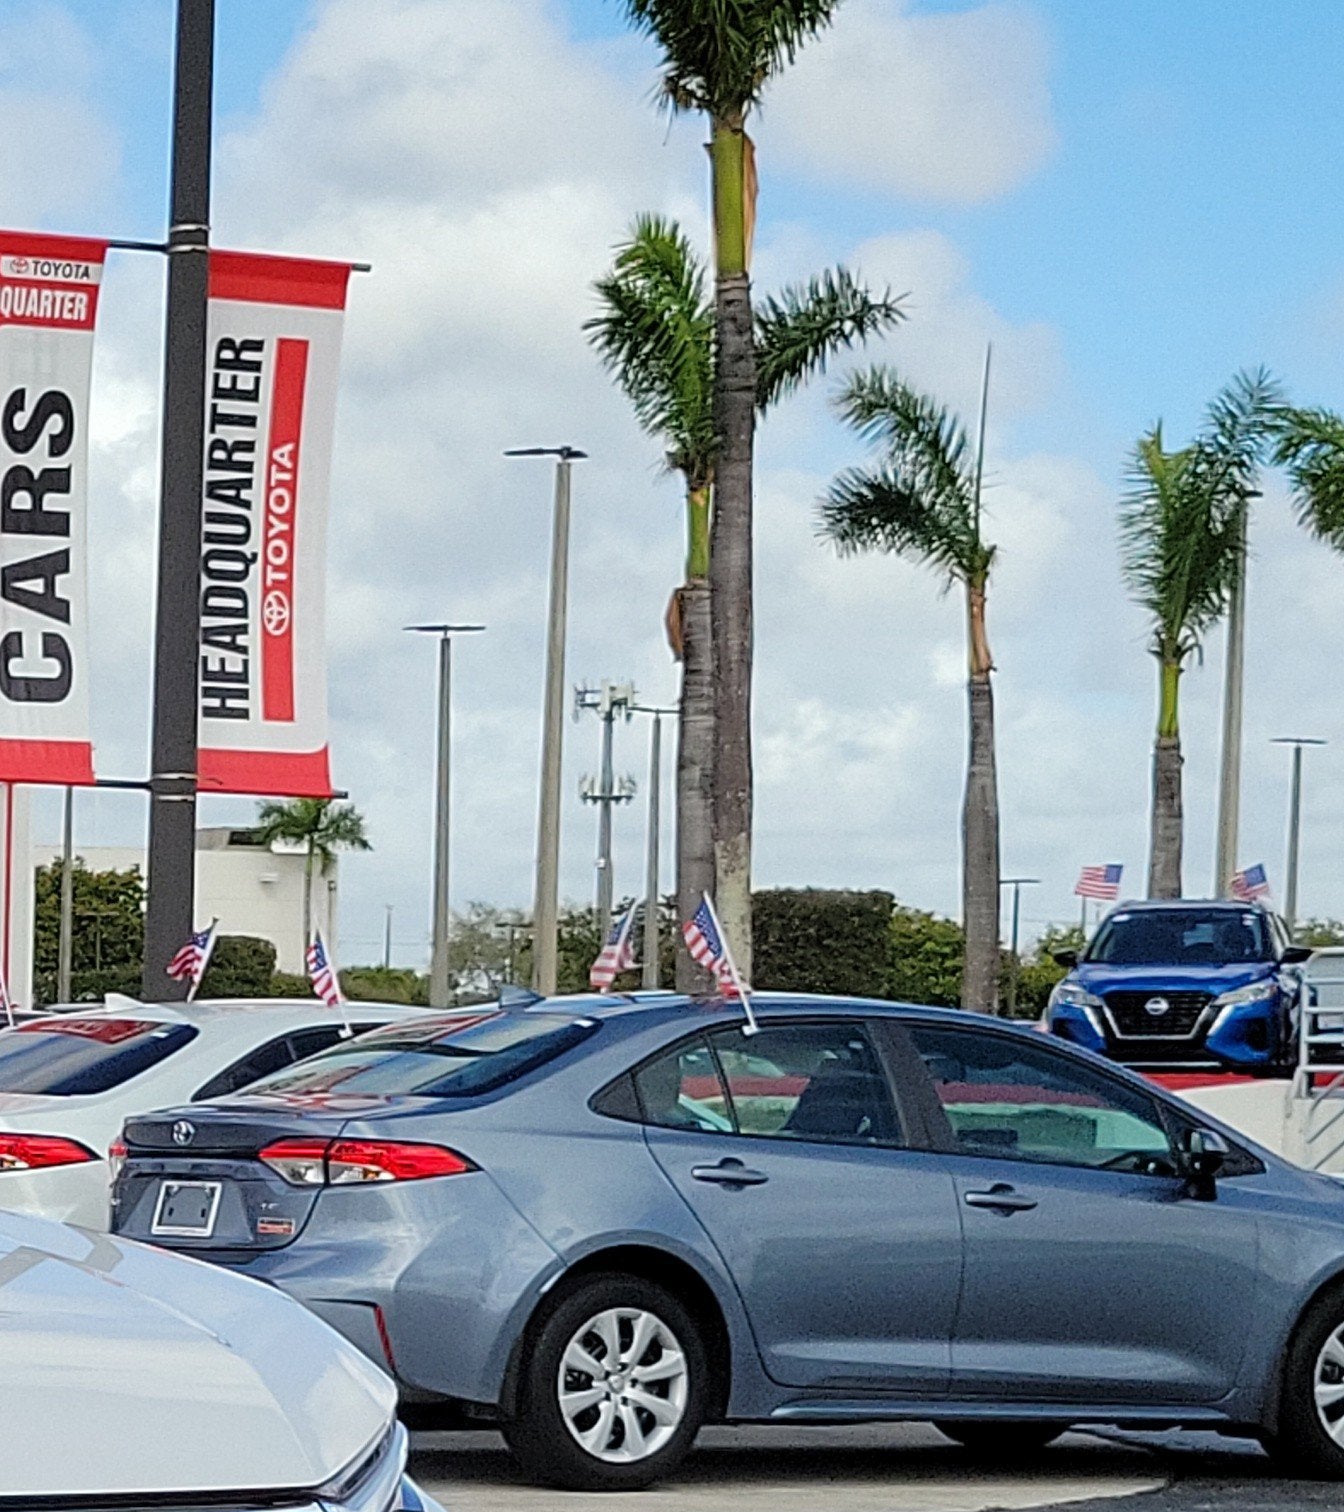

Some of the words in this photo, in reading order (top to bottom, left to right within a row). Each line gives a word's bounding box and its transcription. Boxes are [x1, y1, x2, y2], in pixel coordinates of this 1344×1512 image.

[32, 260, 90, 279] TOYOTA
[202, 336, 264, 720] HEADQUARTER
[264, 443, 294, 585] TOYOTA
